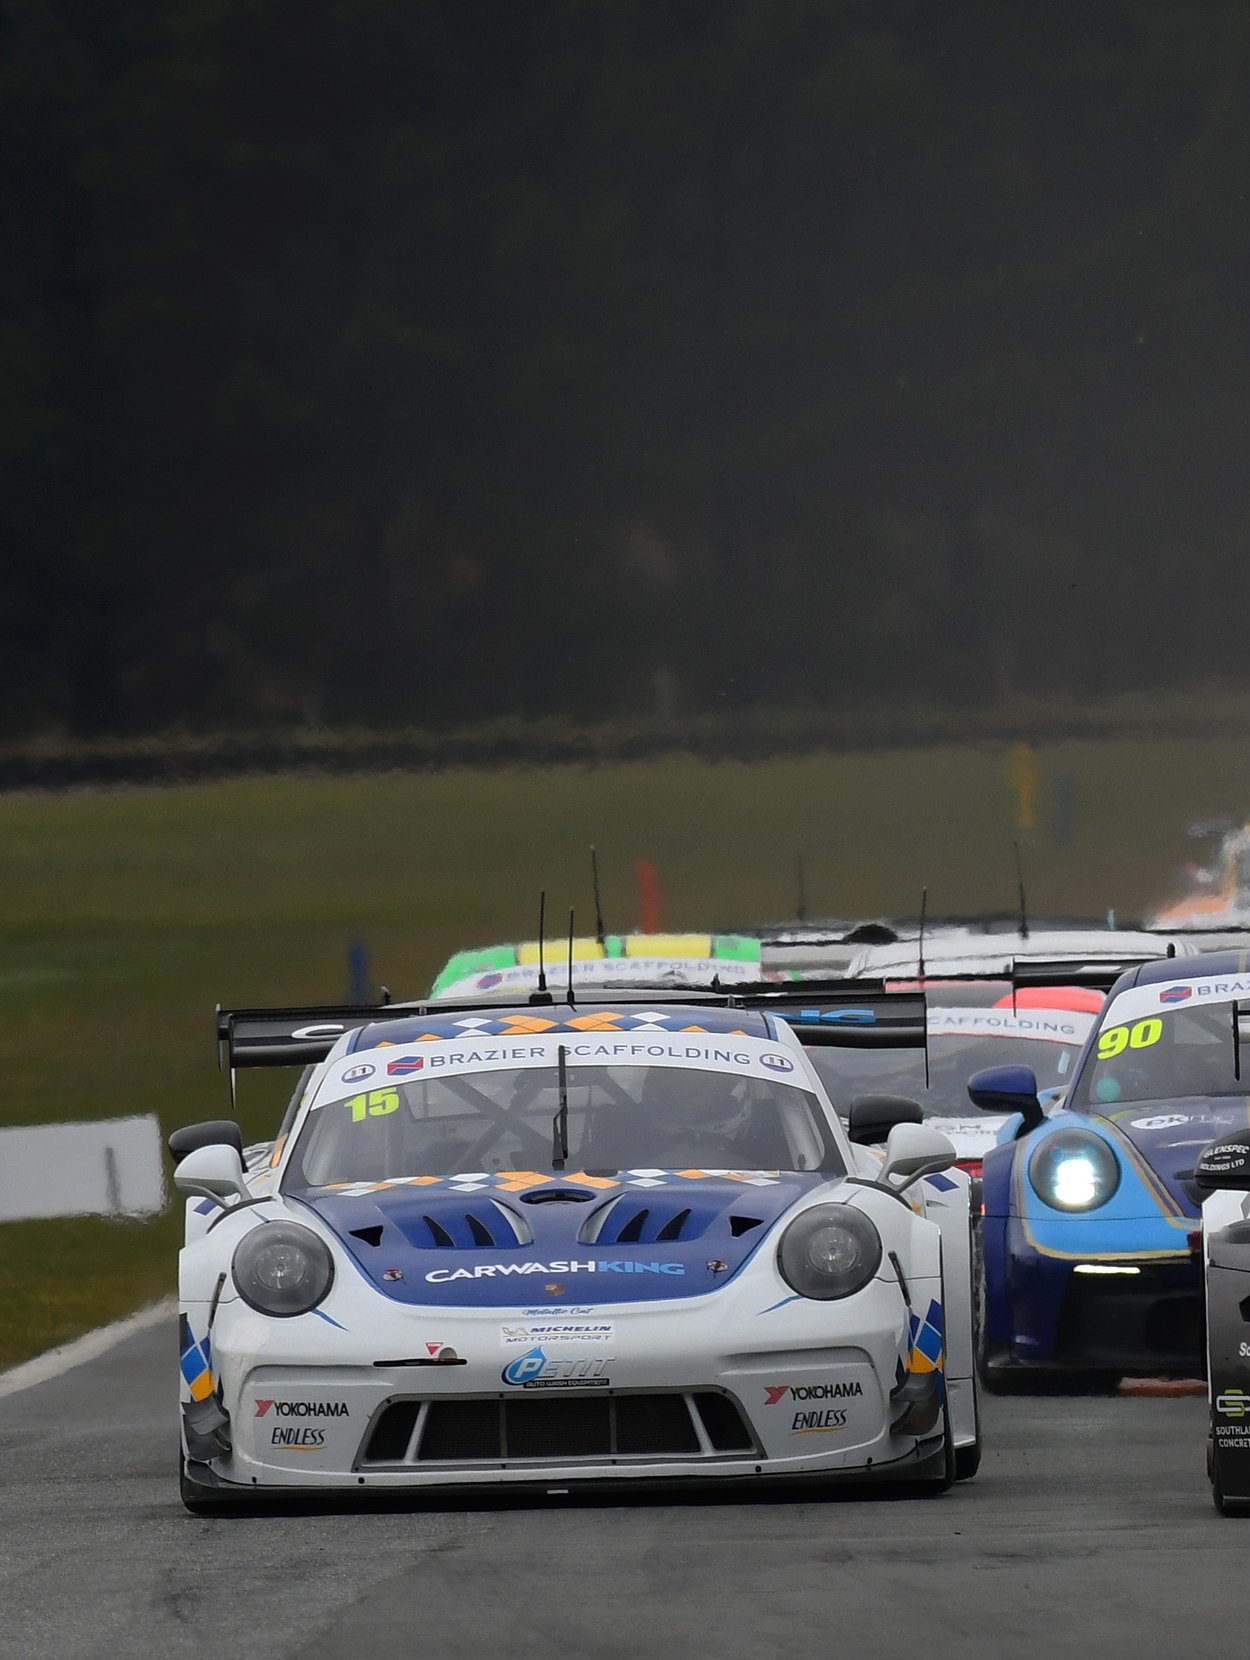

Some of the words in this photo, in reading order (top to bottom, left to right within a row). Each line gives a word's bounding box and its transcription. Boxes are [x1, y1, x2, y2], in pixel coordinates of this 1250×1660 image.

[927, 1015, 1075, 1035] CAFFOLDING
[1096, 1018, 1163, 1060] 90
[430, 1047, 546, 1067] BRAZIER
[564, 1044, 751, 1065] SCAFFOLDING
[343, 1087, 400, 1122] 15
[1203, 1144, 1250, 1159] GLENSPEC
[1231, 1158, 1245, 1169] LTD
[425, 1260, 685, 1283] CARWASHKING
[530, 1325, 612, 1333] MICHELIN
[505, 1335, 612, 1344] MOTORSPORT
[526, 1380, 545, 1388] AUTO
[790, 1382, 864, 1401] YOKOHAMA
[274, 1401, 350, 1417] YOKOHAMA
[791, 1409, 848, 1431] ENDLESS
[271, 1427, 327, 1445] ENDLESS
